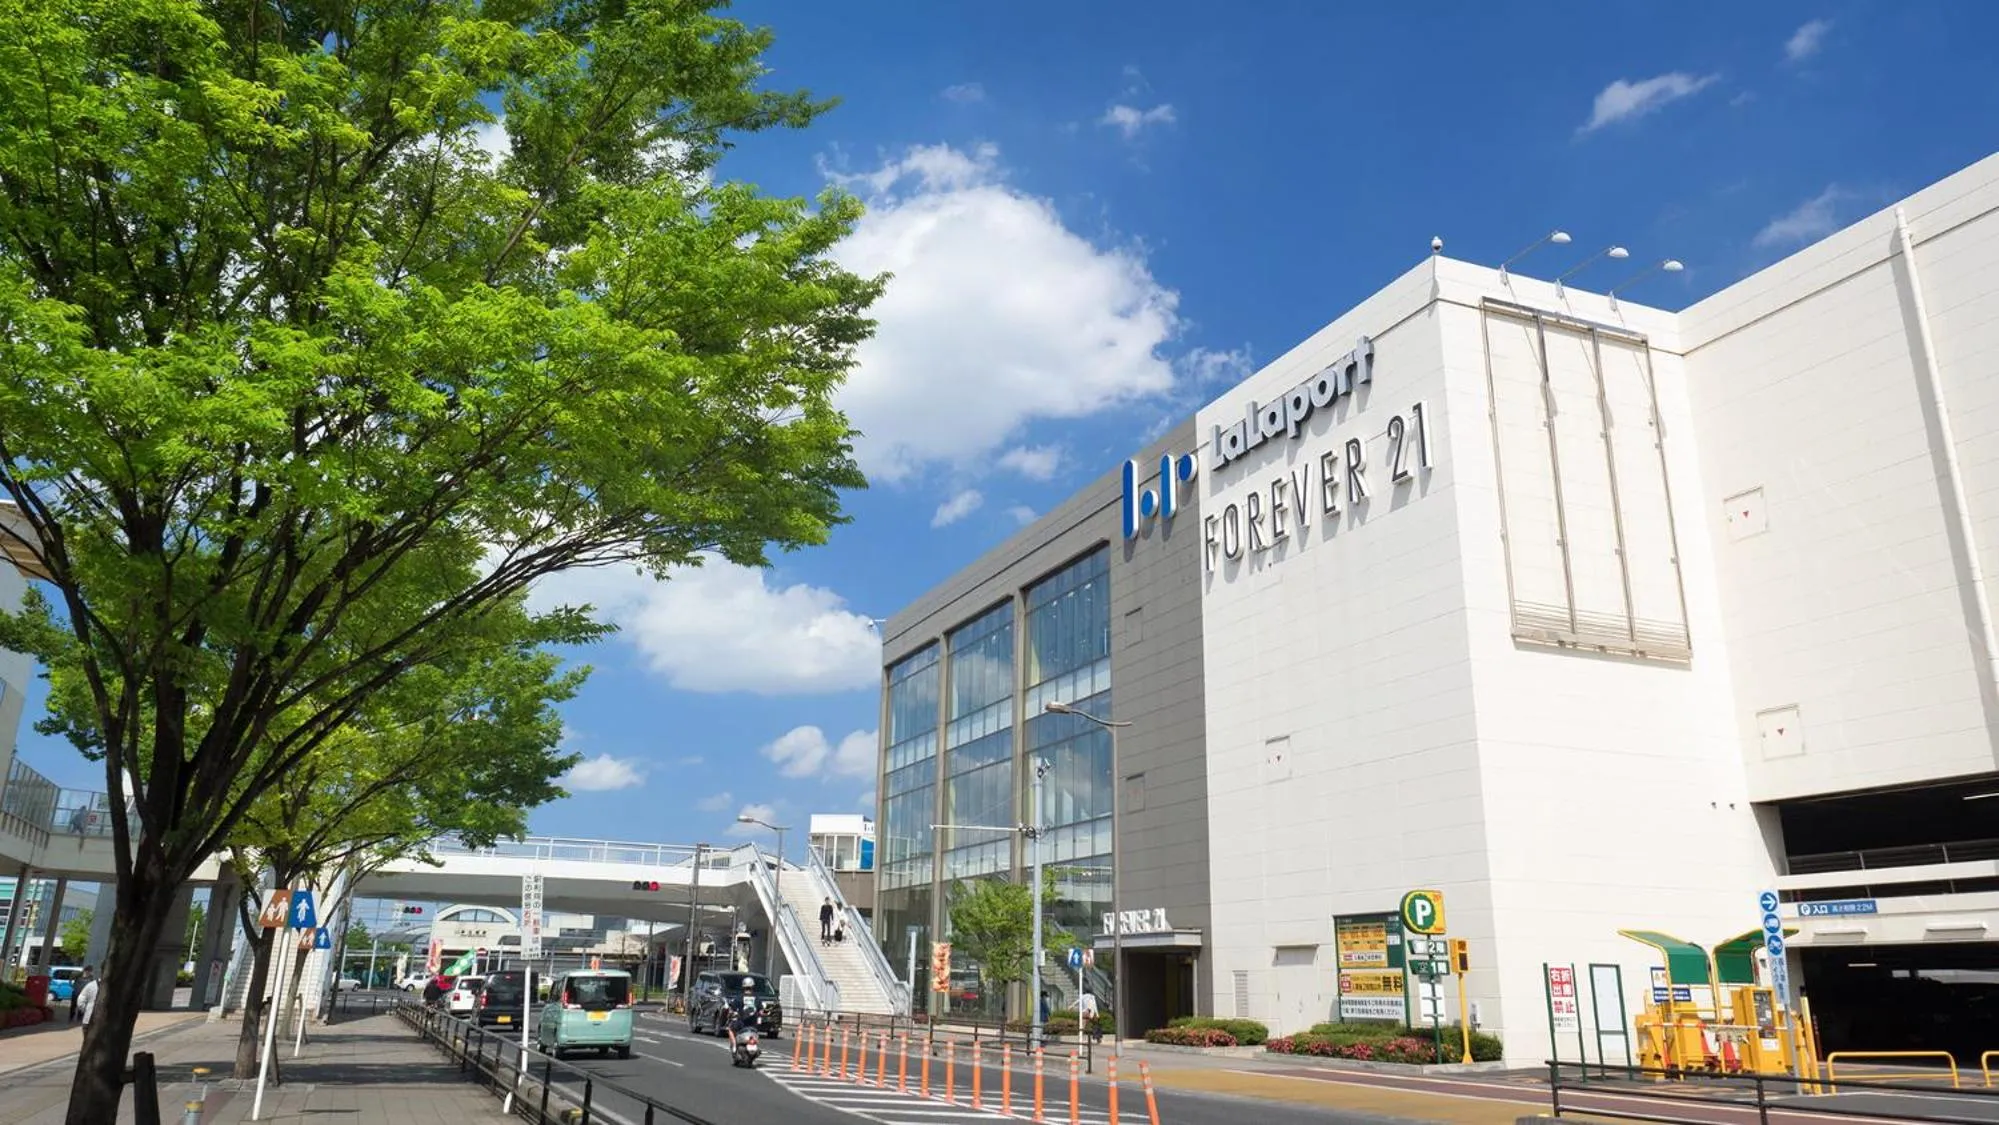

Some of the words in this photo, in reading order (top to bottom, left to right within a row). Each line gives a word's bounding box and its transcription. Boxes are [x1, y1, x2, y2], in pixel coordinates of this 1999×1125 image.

[1209, 335, 1374, 472] LaLaport
[1204, 437, 1370, 573] FOREVER
[1387, 400, 1433, 485] 21
[1415, 899, 1432, 926] P
[1382, 975, 1403, 992] 無料
